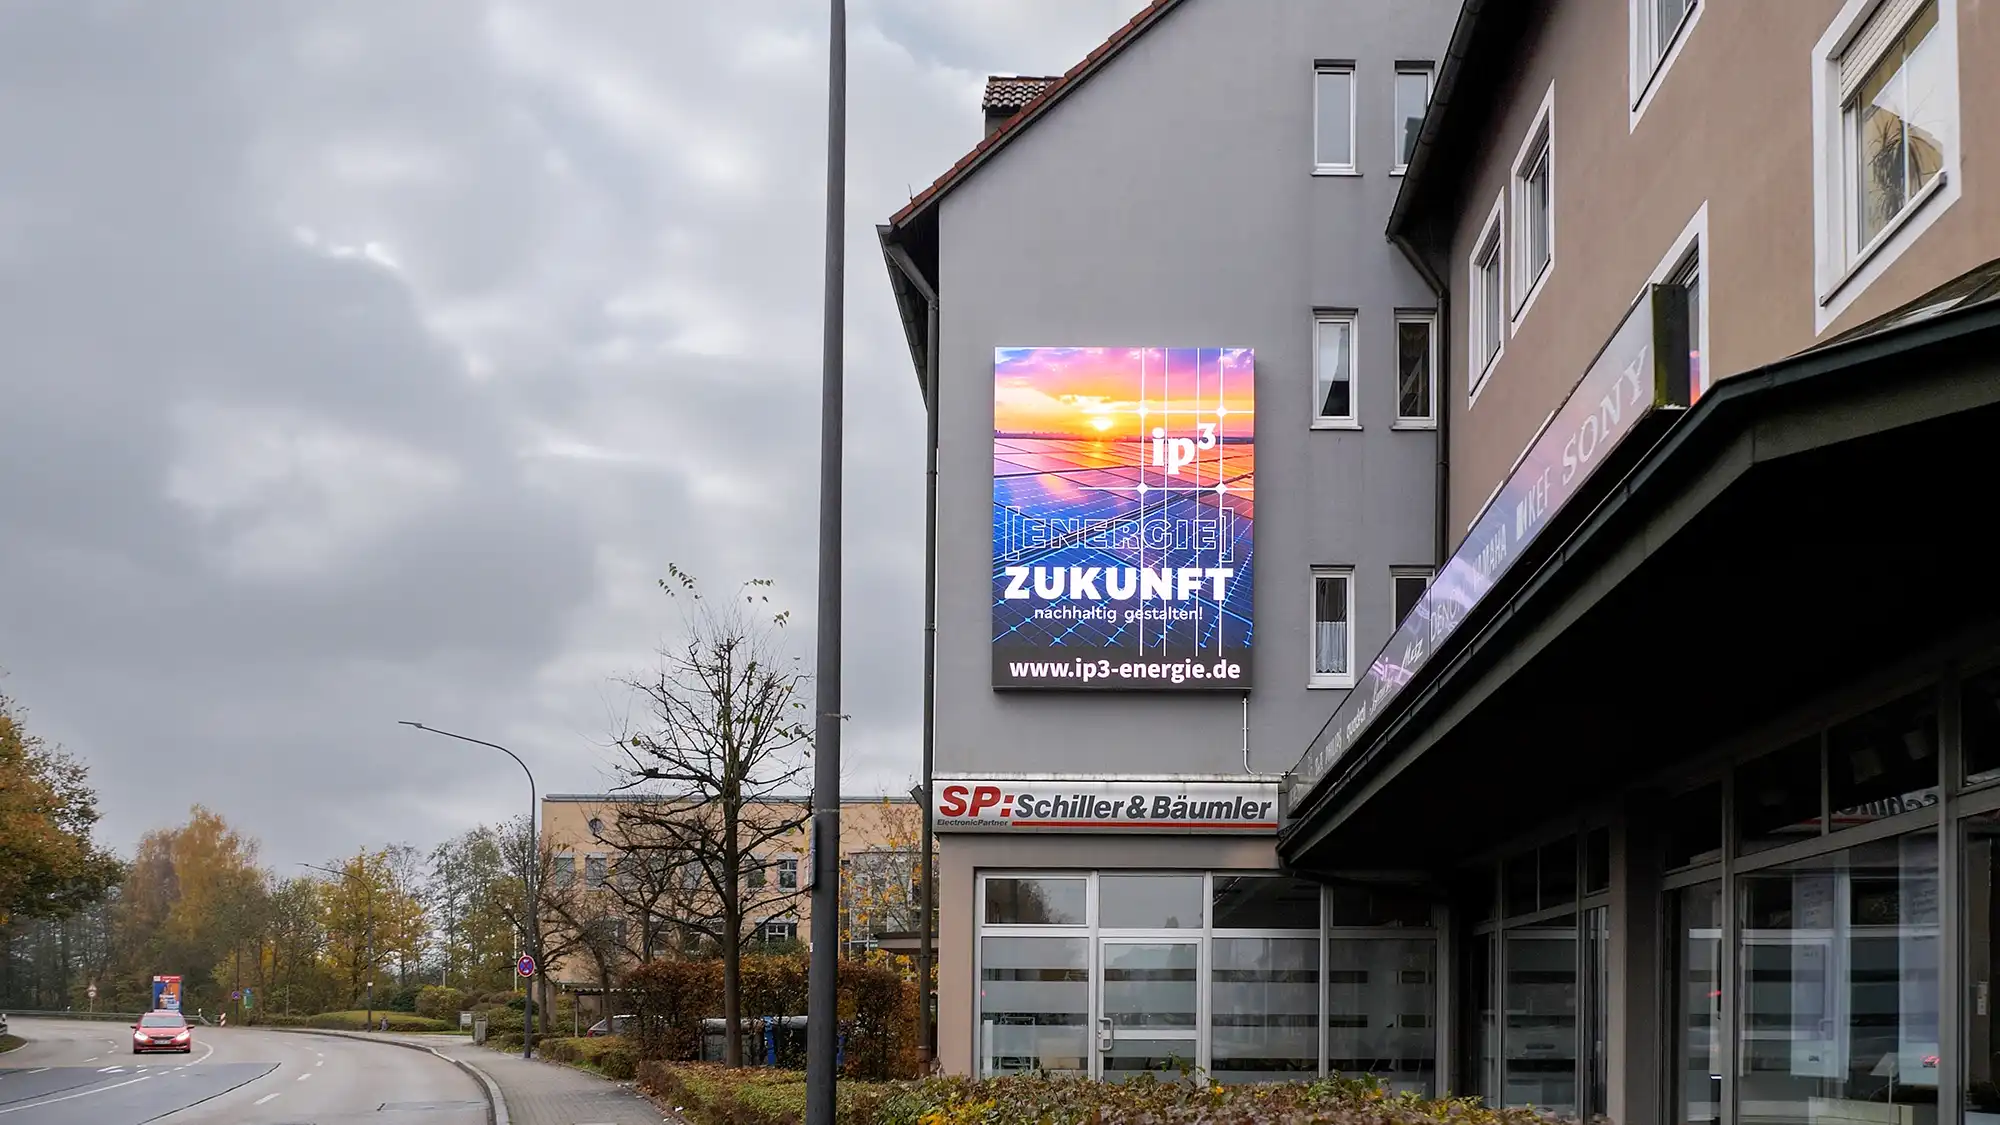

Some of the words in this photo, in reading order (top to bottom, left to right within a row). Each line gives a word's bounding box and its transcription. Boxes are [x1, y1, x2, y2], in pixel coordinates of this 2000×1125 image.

[1562, 344, 1648, 487] SONY
[1004, 566, 1234, 601] ZUKUNFT
[1034, 606, 1117, 623] nachhaltig
[1124, 606, 1203, 624] gestalten!
[1009, 657, 1241, 684] www.ip3-energie.de
[937, 819, 1008, 827] ElectronicPartner
